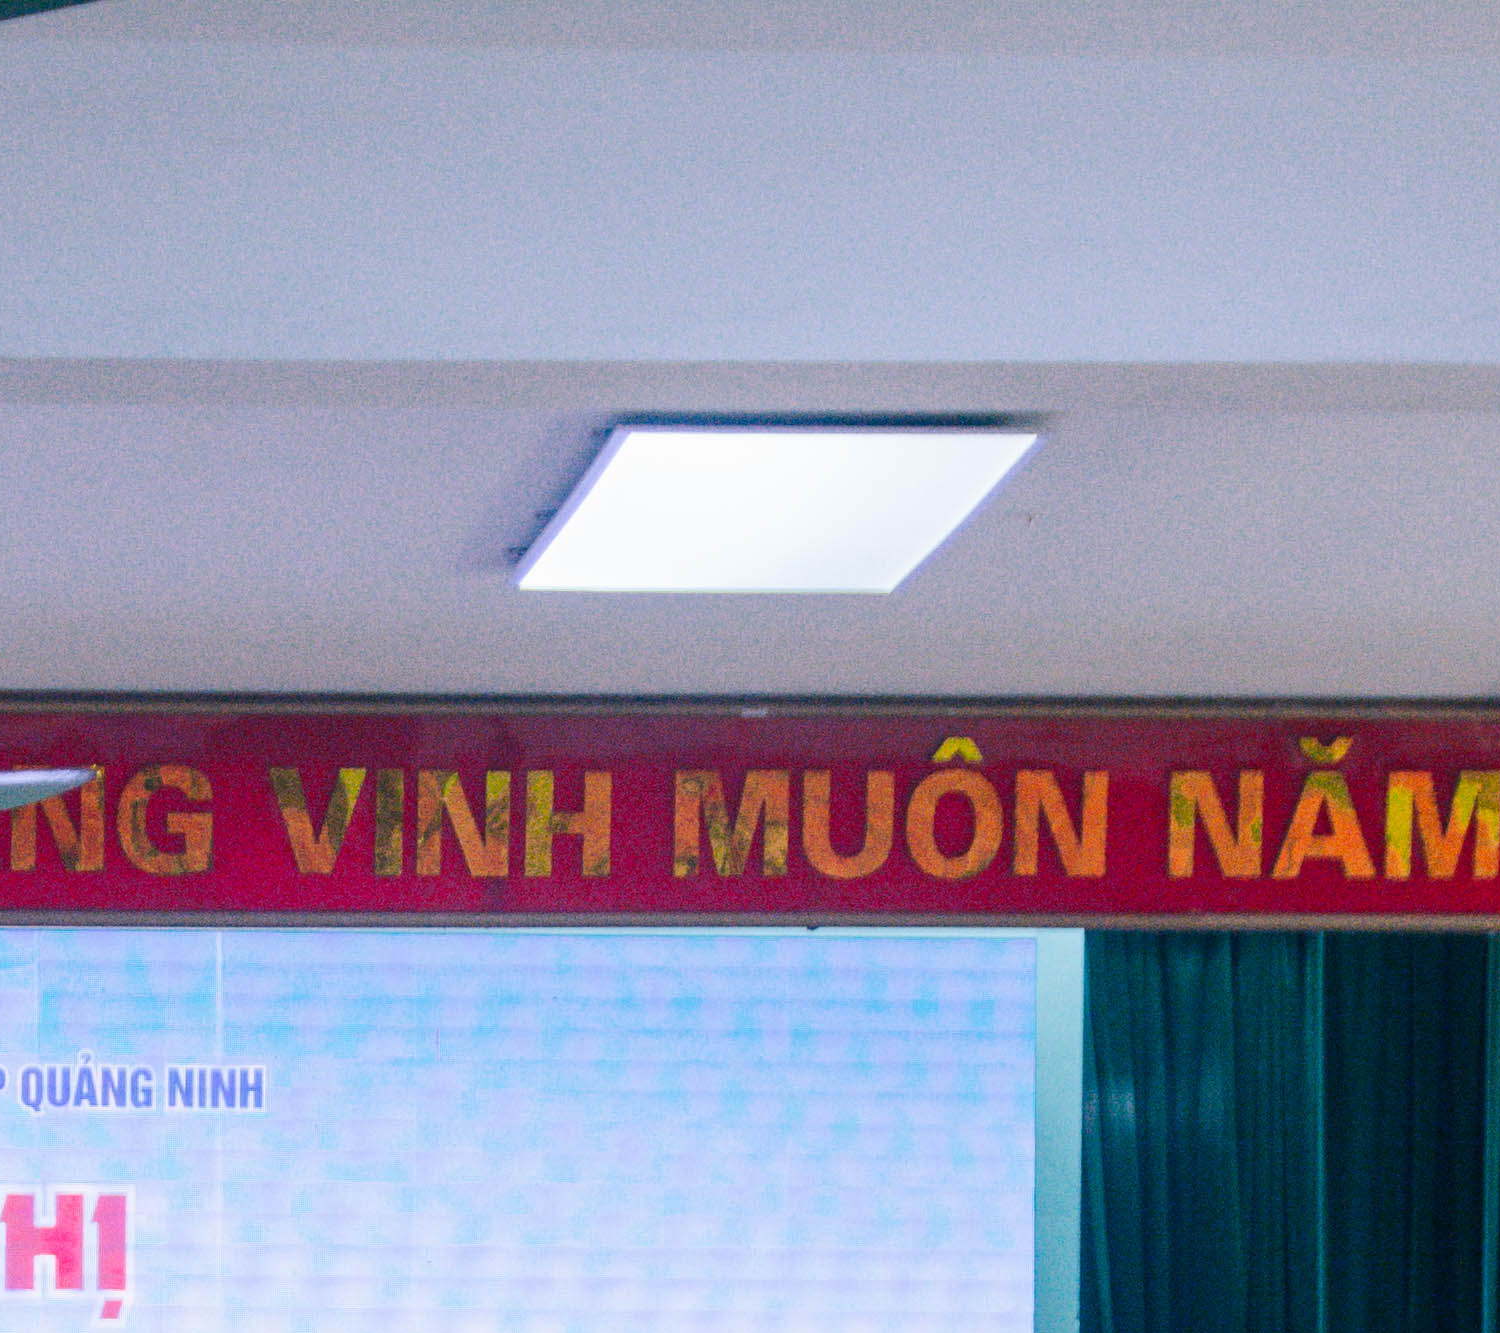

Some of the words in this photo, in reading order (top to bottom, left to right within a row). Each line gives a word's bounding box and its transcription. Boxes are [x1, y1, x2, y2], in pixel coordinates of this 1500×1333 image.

[270, 767, 614, 880] VINH
[673, 735, 1109, 881] MUÔN
[22, 1053, 153, 1112] QUẢNG
[169, 1070, 262, 1107] NINH
